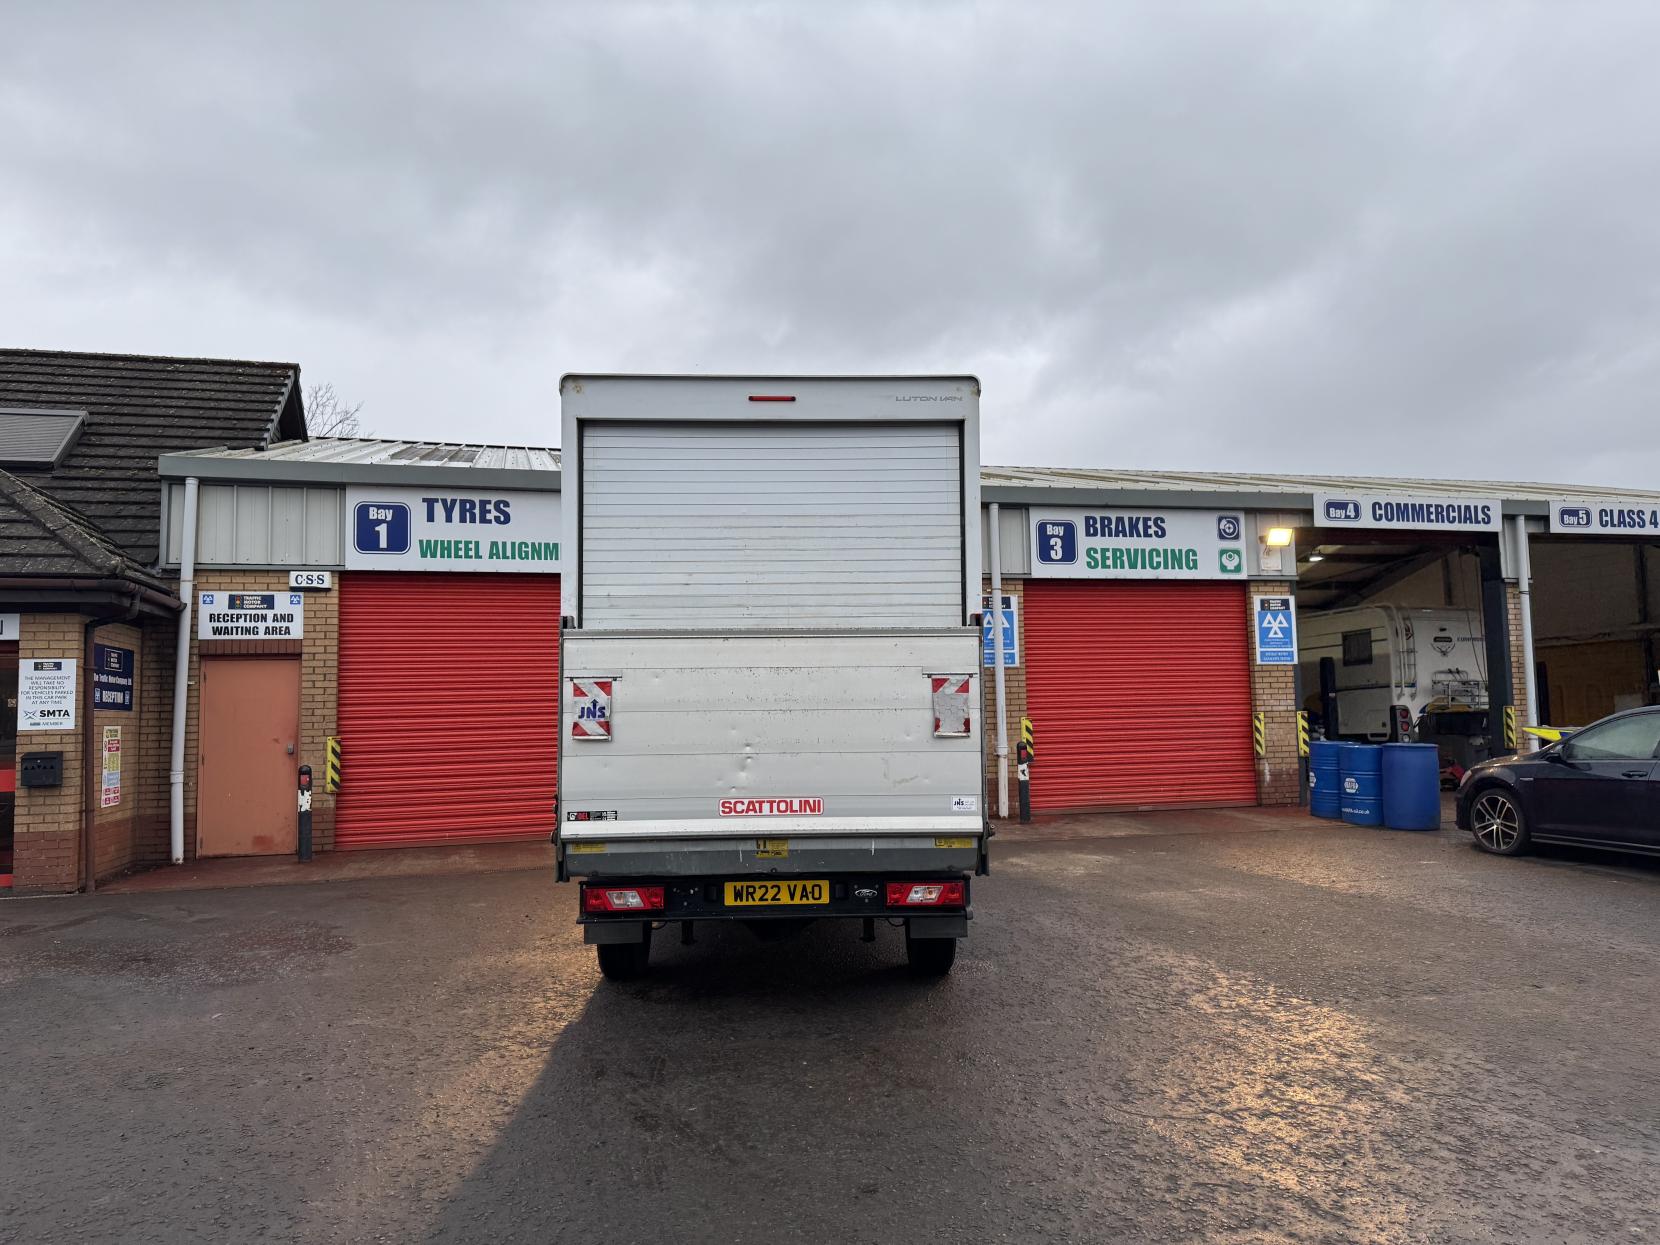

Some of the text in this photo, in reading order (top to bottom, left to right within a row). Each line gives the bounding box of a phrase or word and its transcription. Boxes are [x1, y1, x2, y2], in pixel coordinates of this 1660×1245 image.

[369, 507, 393, 521] Bay
[422, 498, 511, 525] TYRES
[1329, 503, 1356, 519] Bay 4
[1371, 502, 1492, 525] COMMERCIALS
[1563, 510, 1587, 525] Bay 5
[1598, 508, 1659, 528] CLASS 4
[375, 523, 388, 549] 1
[1046, 524, 1064, 536] Bay
[1084, 516, 1167, 538] BRAKES
[418, 539, 560, 561] WHEEL ALIGNM
[1050, 537, 1062, 560] 3
[1086, 547, 1198, 570] SERVICING
[209, 613, 294, 623] RECEPTION AND
[211, 626, 291, 636] WAITING AREA
[39, 709, 70, 718] SMTA
[578, 701, 606, 719] JNS
[721, 799, 821, 815] SCATTOLINI
[733, 883, 822, 902] WR22 VAO
